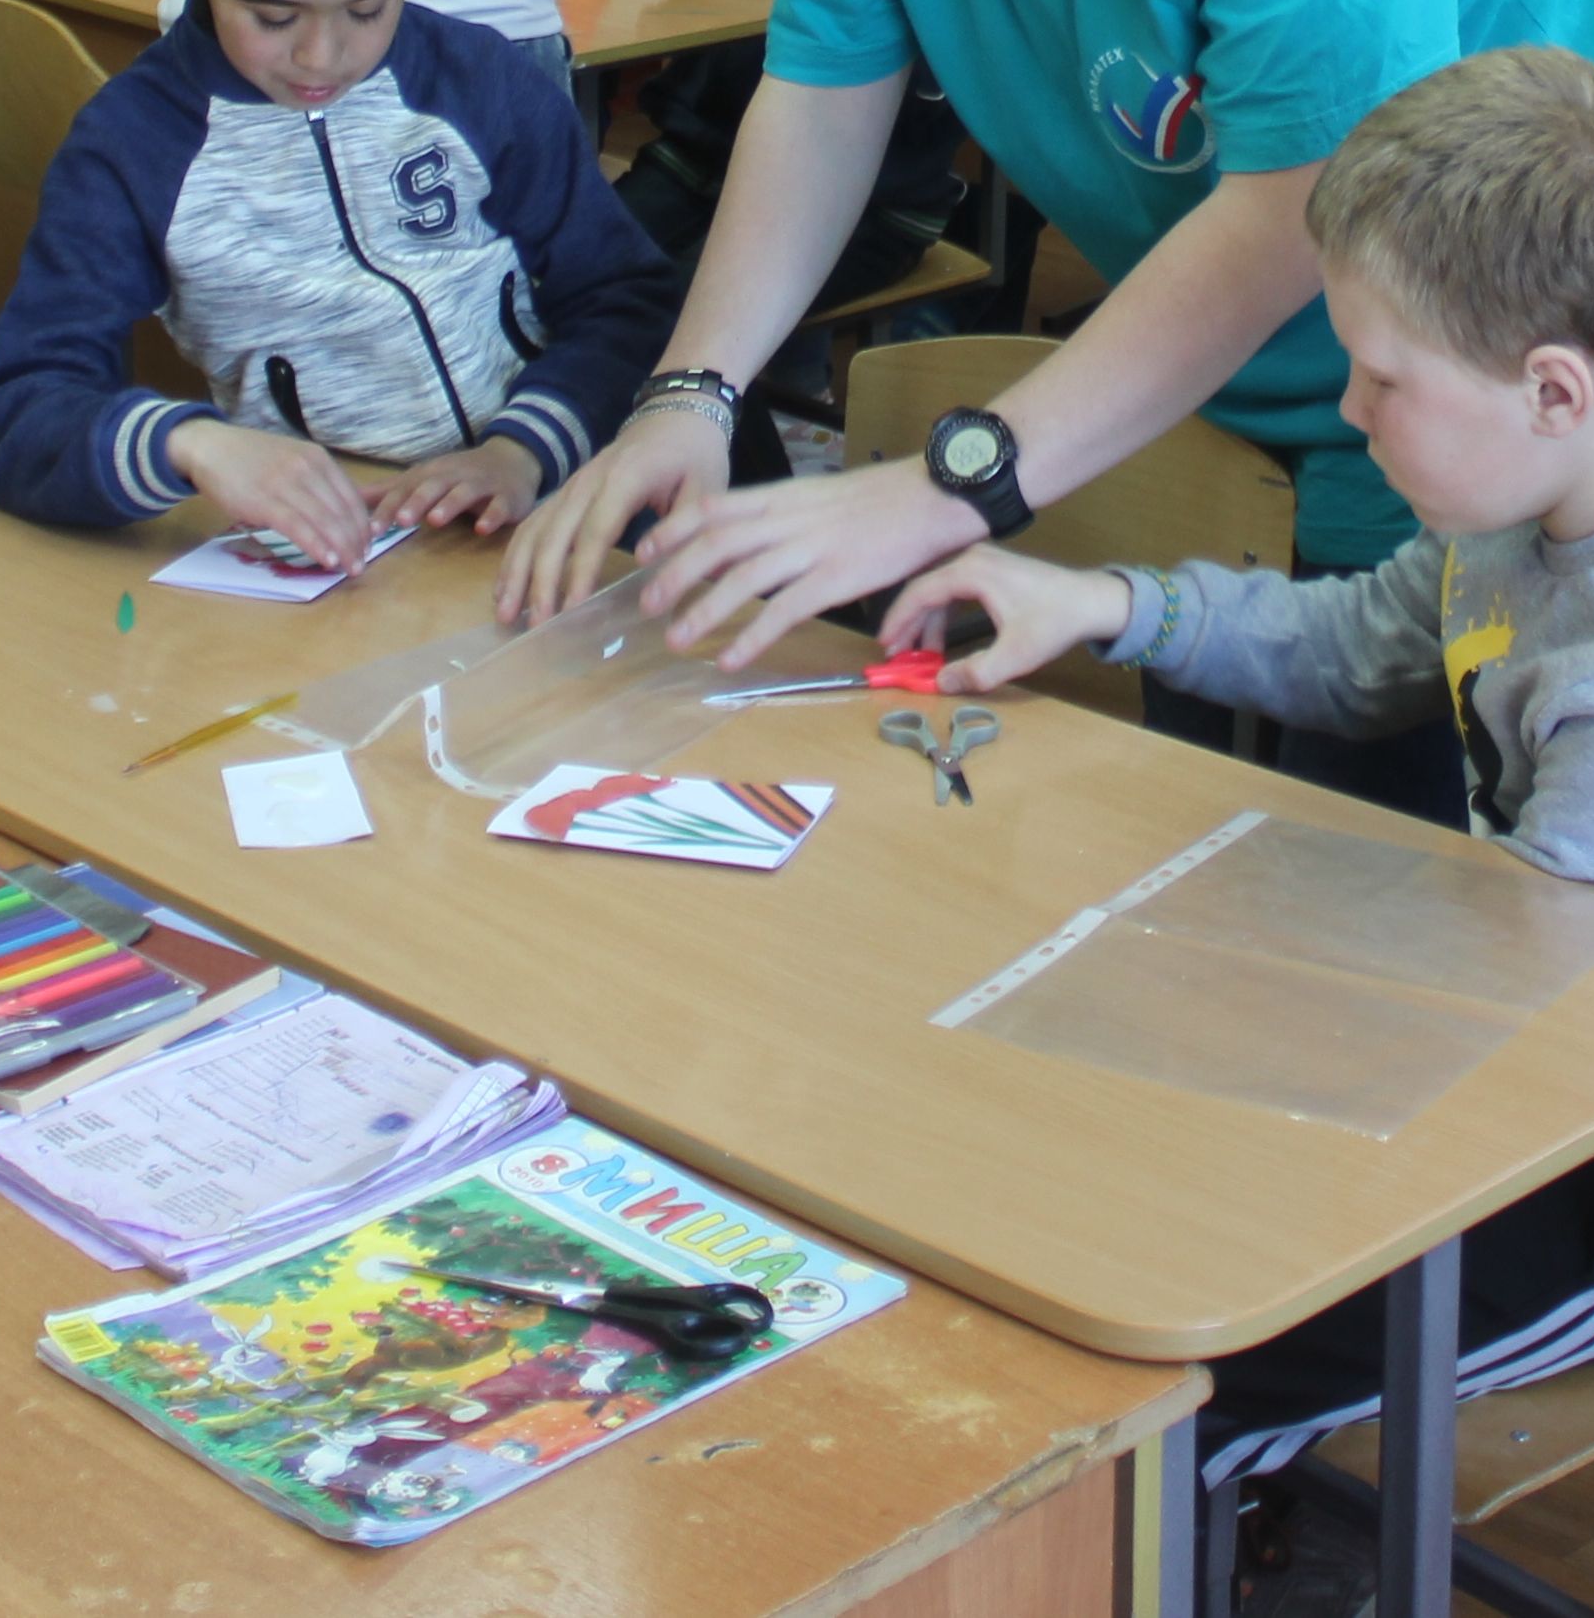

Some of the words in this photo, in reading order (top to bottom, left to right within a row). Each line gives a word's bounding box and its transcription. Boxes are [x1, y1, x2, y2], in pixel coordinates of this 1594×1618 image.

[389, 143, 457, 240] S
[507, 1165, 545, 1189] 2010
[530, 1154, 569, 1175] 8
[558, 1154, 808, 1291] МИША
